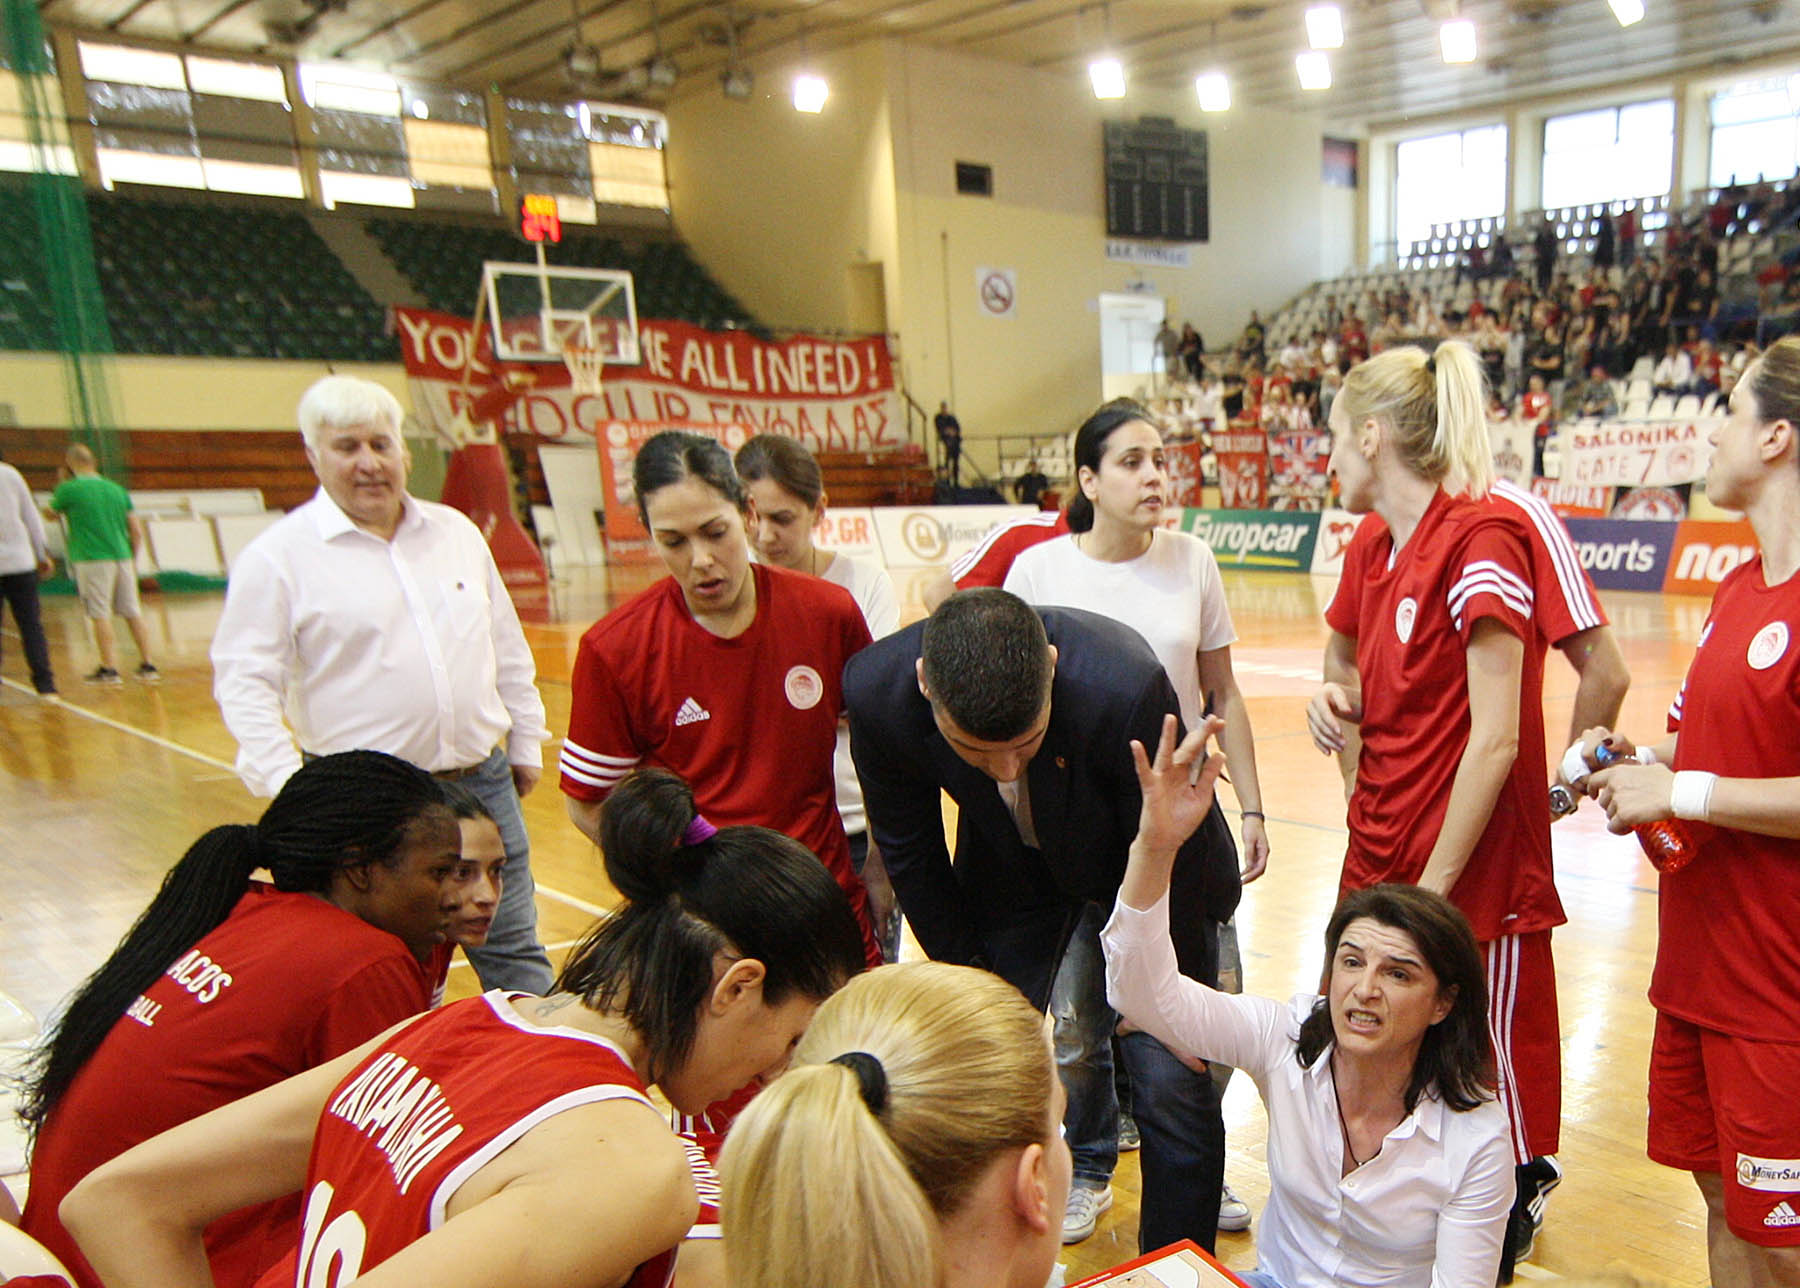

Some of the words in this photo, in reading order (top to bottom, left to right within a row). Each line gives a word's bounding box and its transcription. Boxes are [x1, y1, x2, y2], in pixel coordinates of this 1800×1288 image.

[681, 338, 750, 392] ALL
[753, 346, 766, 392] I
[1573, 424, 1698, 449] SALONIKA
[1637, 448, 1657, 484] 7
[1194, 514, 1310, 563] Europcar
